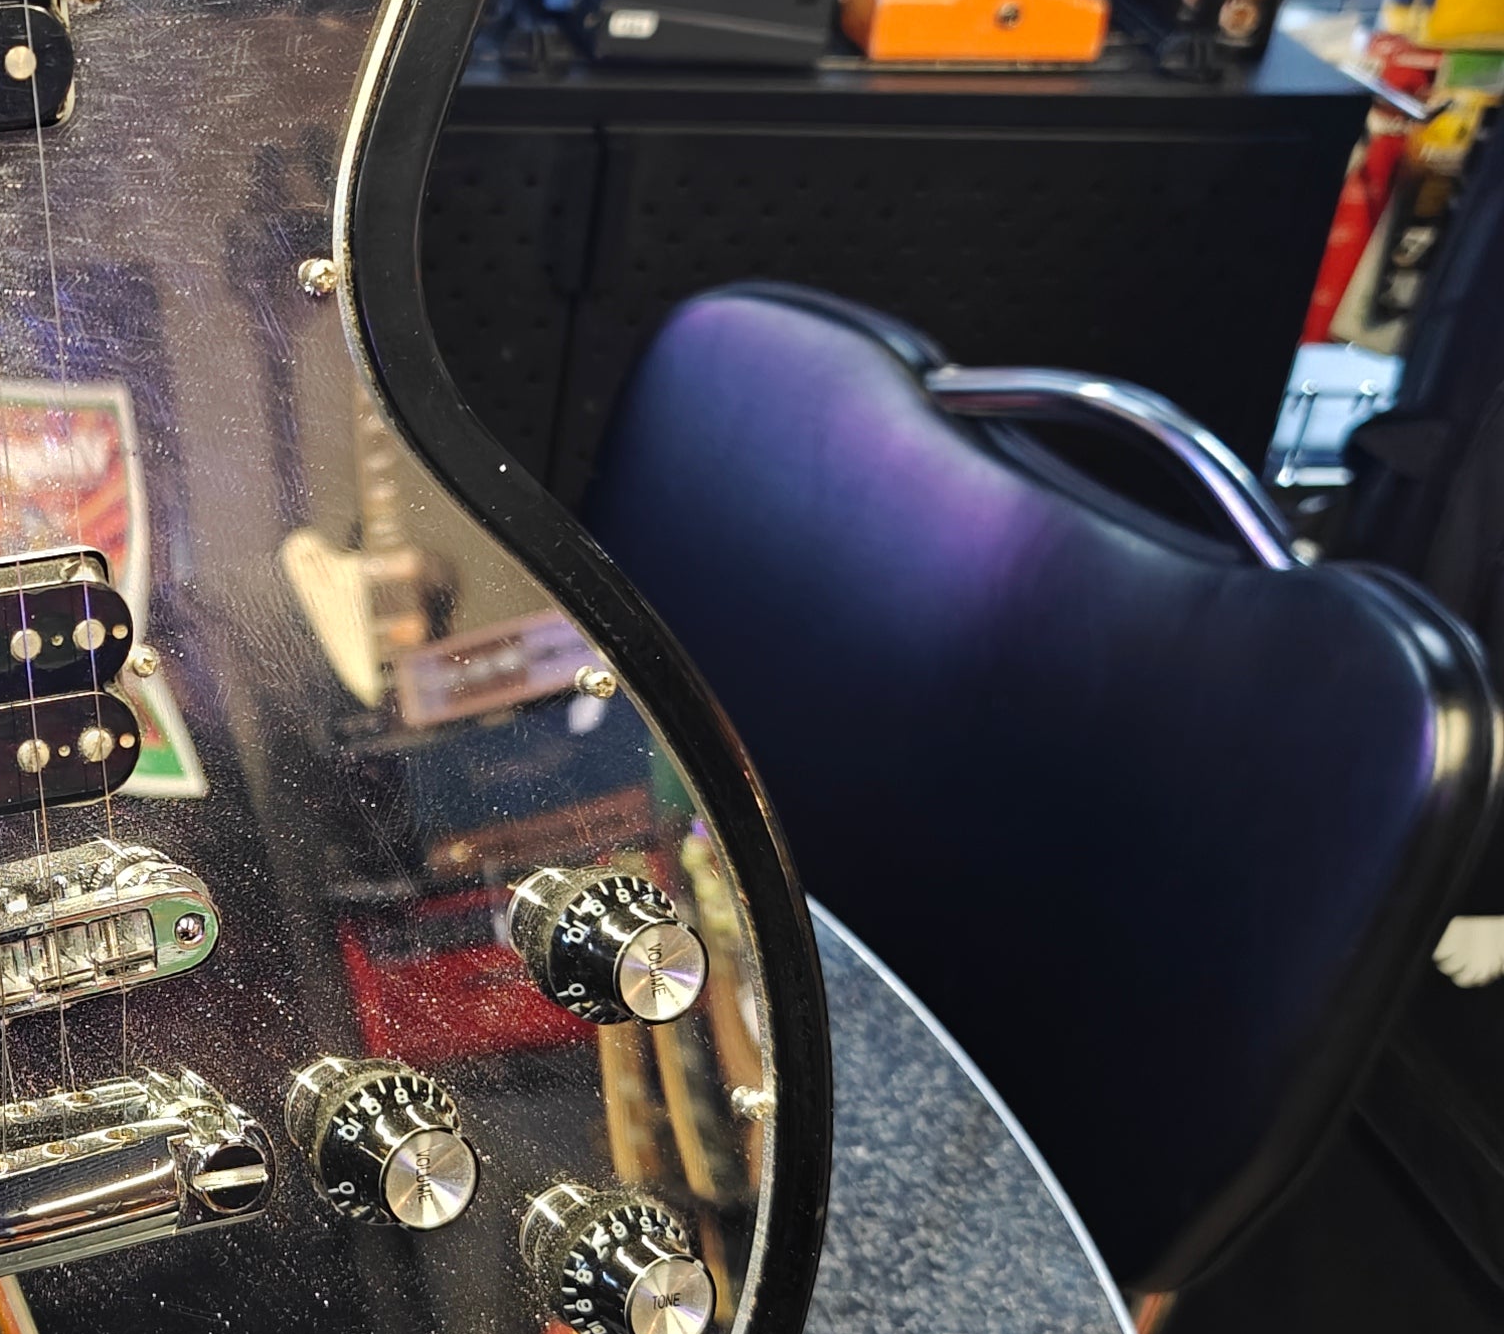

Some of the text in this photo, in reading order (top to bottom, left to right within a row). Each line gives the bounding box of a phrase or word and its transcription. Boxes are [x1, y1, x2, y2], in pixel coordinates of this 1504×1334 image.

[647, 943, 668, 999] VOLUME
[415, 1149, 434, 1205] VOLUME
[575, 1268, 593, 1285] 8
[652, 1292, 681, 1310] TONE
